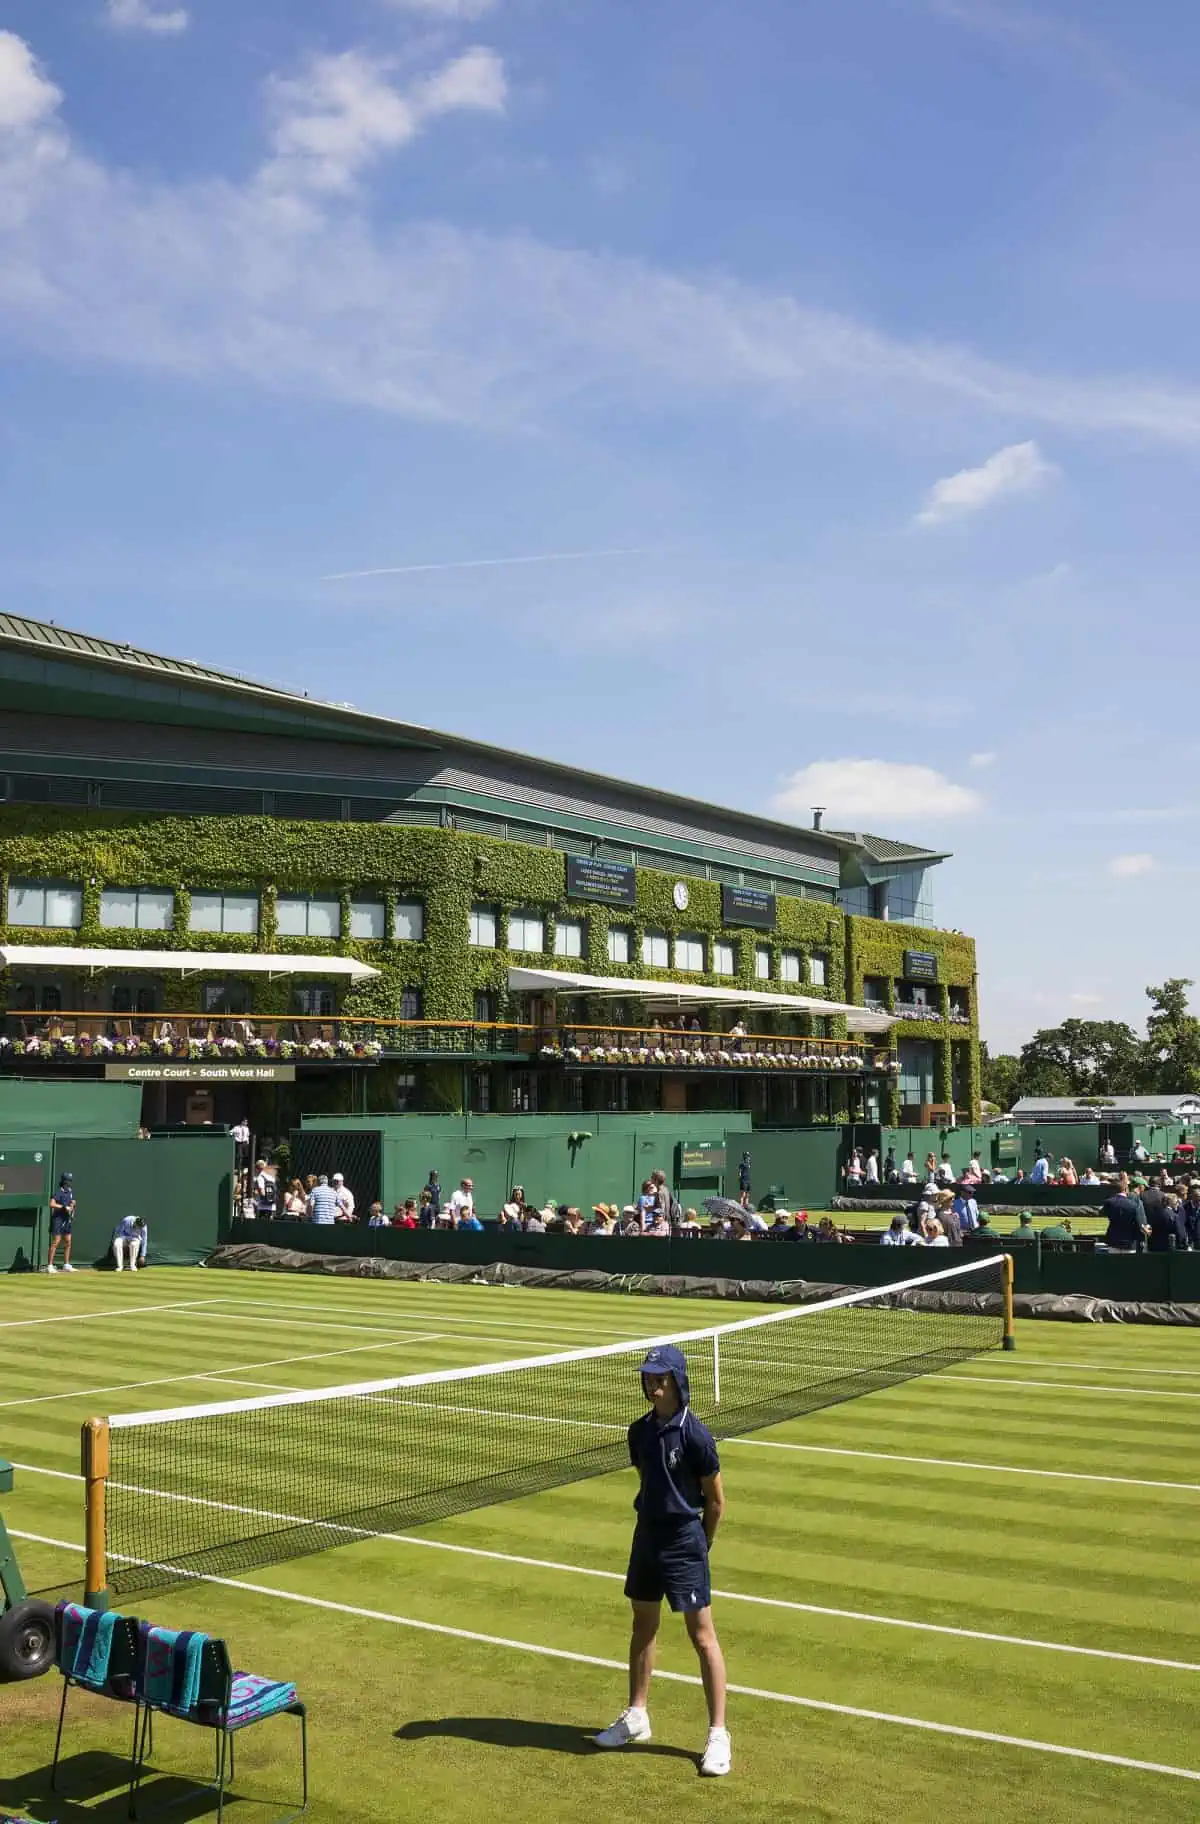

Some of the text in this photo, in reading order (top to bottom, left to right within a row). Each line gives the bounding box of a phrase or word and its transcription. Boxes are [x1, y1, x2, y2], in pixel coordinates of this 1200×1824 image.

[128, 1068, 160, 1077] Centre
[163, 1068, 190, 1077] Court
[200, 1068, 228, 1077] South
[230, 1068, 254, 1077] West
[256, 1068, 275, 1077] Hall
